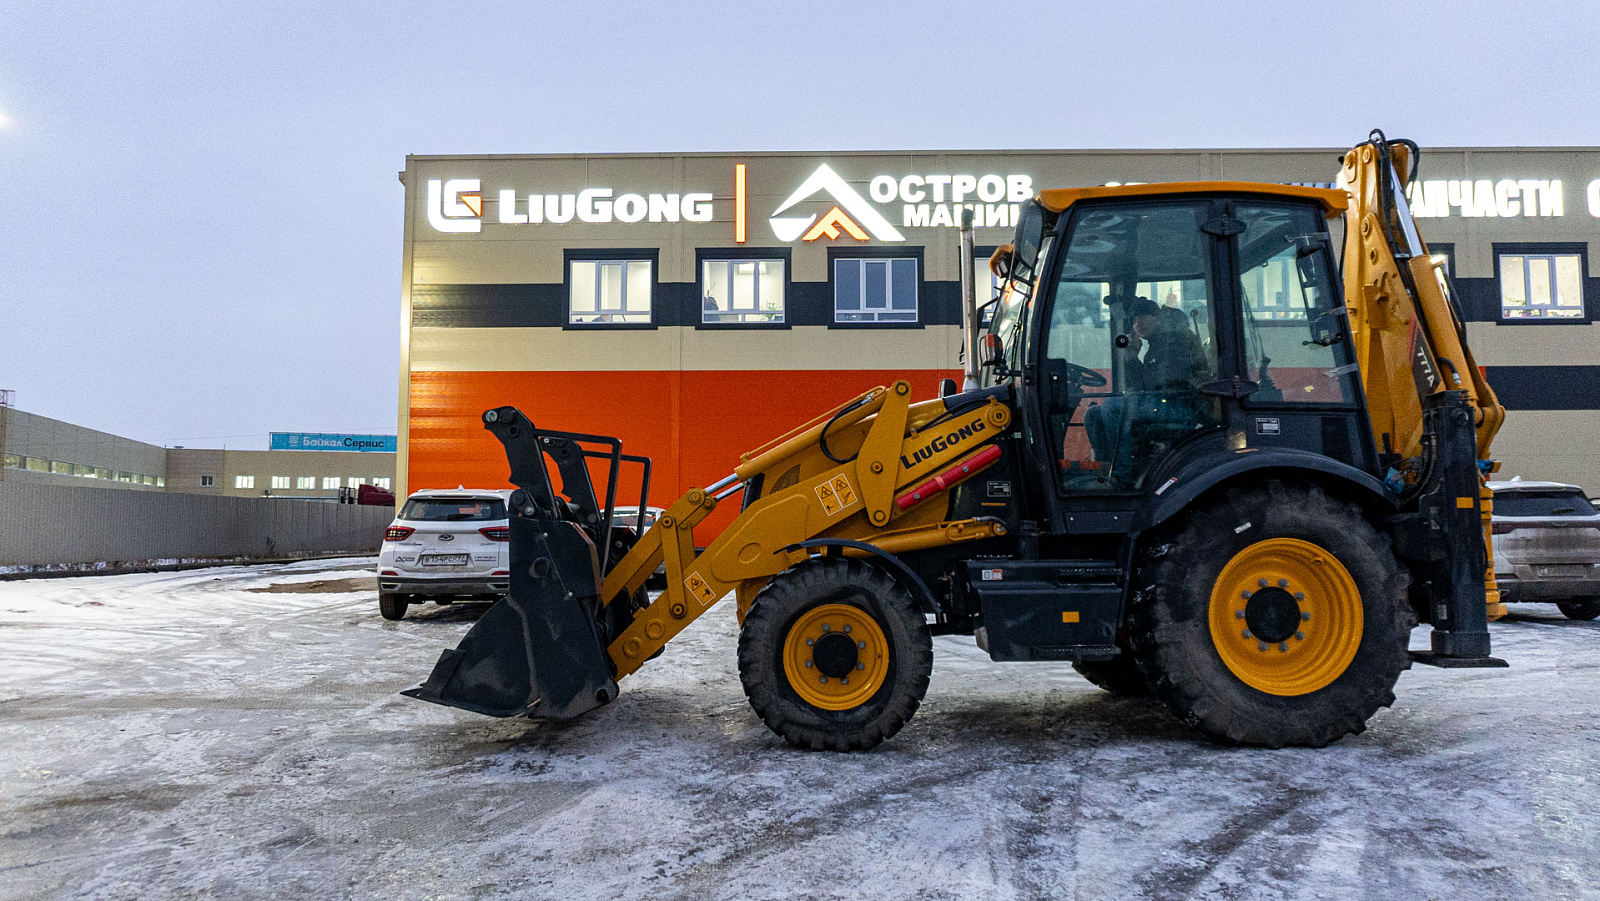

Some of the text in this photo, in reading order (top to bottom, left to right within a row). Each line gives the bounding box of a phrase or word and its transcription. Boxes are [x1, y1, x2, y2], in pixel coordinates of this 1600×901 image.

[869, 174, 1034, 203] ОСТРОВ
[1406, 179, 1564, 218] АПЧАСТИ
[303, 436, 342, 447] Байкал
[344, 437, 384, 450] Сервис
